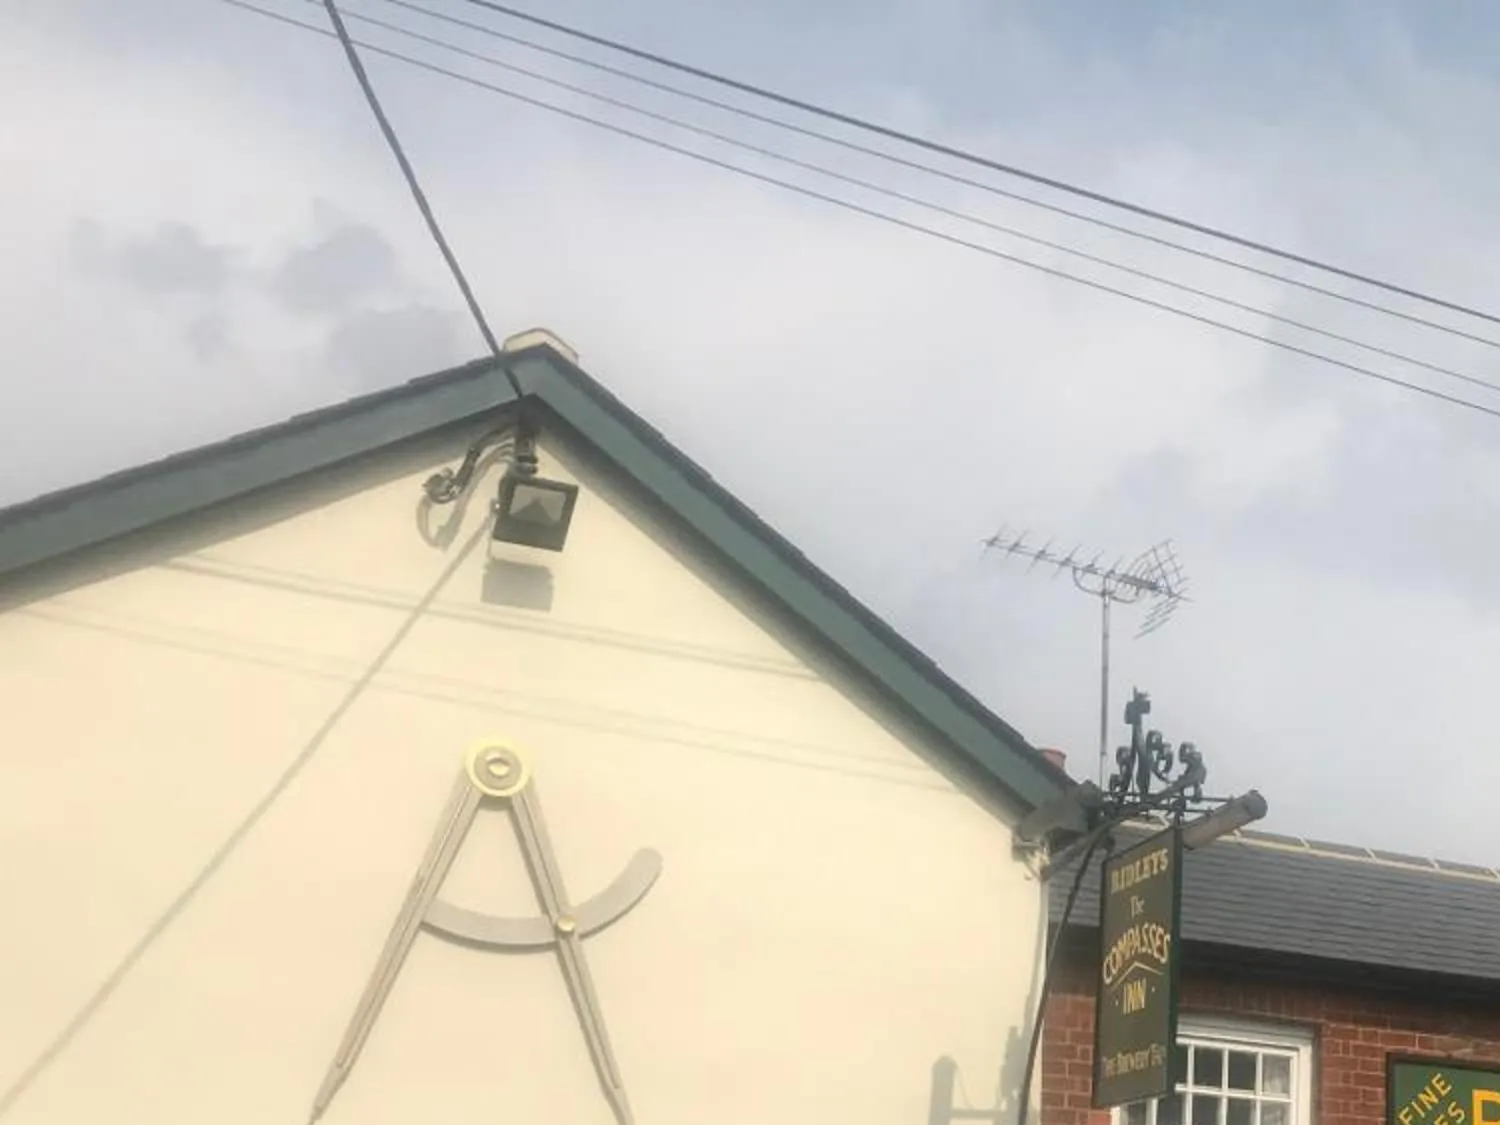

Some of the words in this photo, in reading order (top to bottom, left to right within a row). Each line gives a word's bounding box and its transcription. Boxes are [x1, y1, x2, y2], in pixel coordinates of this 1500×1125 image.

[1110, 848, 1169, 894] RIDLEYS
[1103, 921, 1171, 985] COMPASSES
[1123, 978, 1147, 1016] INN
